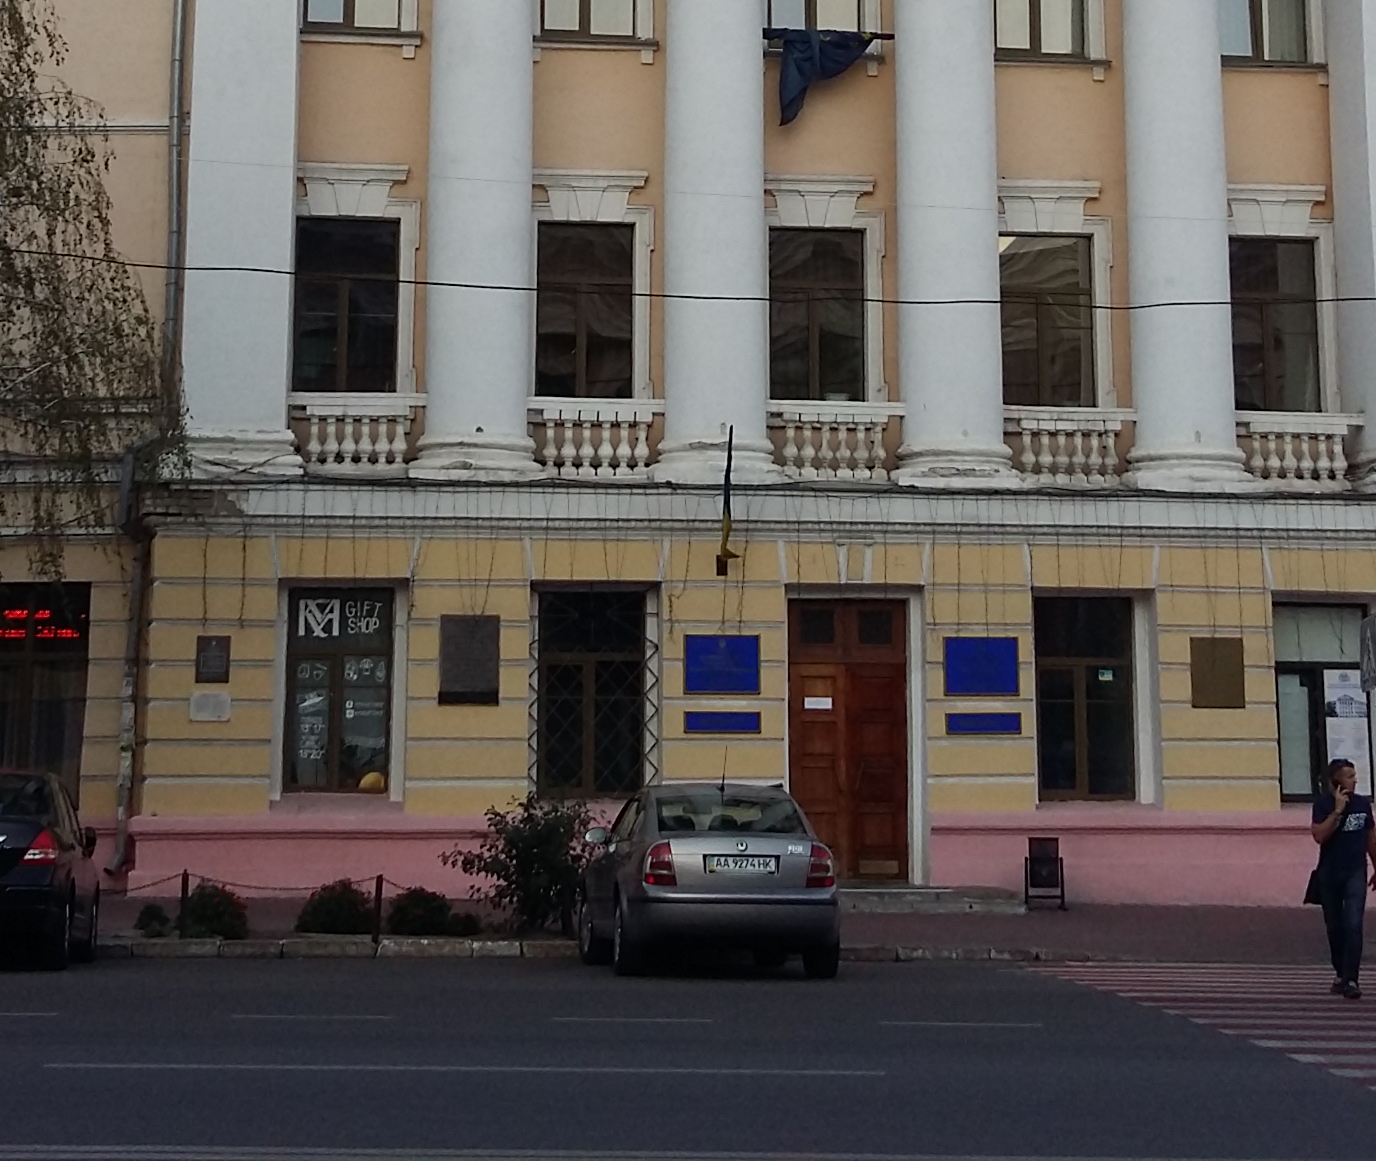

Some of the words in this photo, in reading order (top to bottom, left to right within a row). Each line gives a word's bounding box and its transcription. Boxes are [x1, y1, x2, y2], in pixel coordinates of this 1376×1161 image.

[345, 600, 383, 618] GIFT
[347, 617, 380, 634] SHOP
[715, 859, 730, 869] AA
[732, 859, 756, 870] 9274
[758, 859, 773, 869] HK
